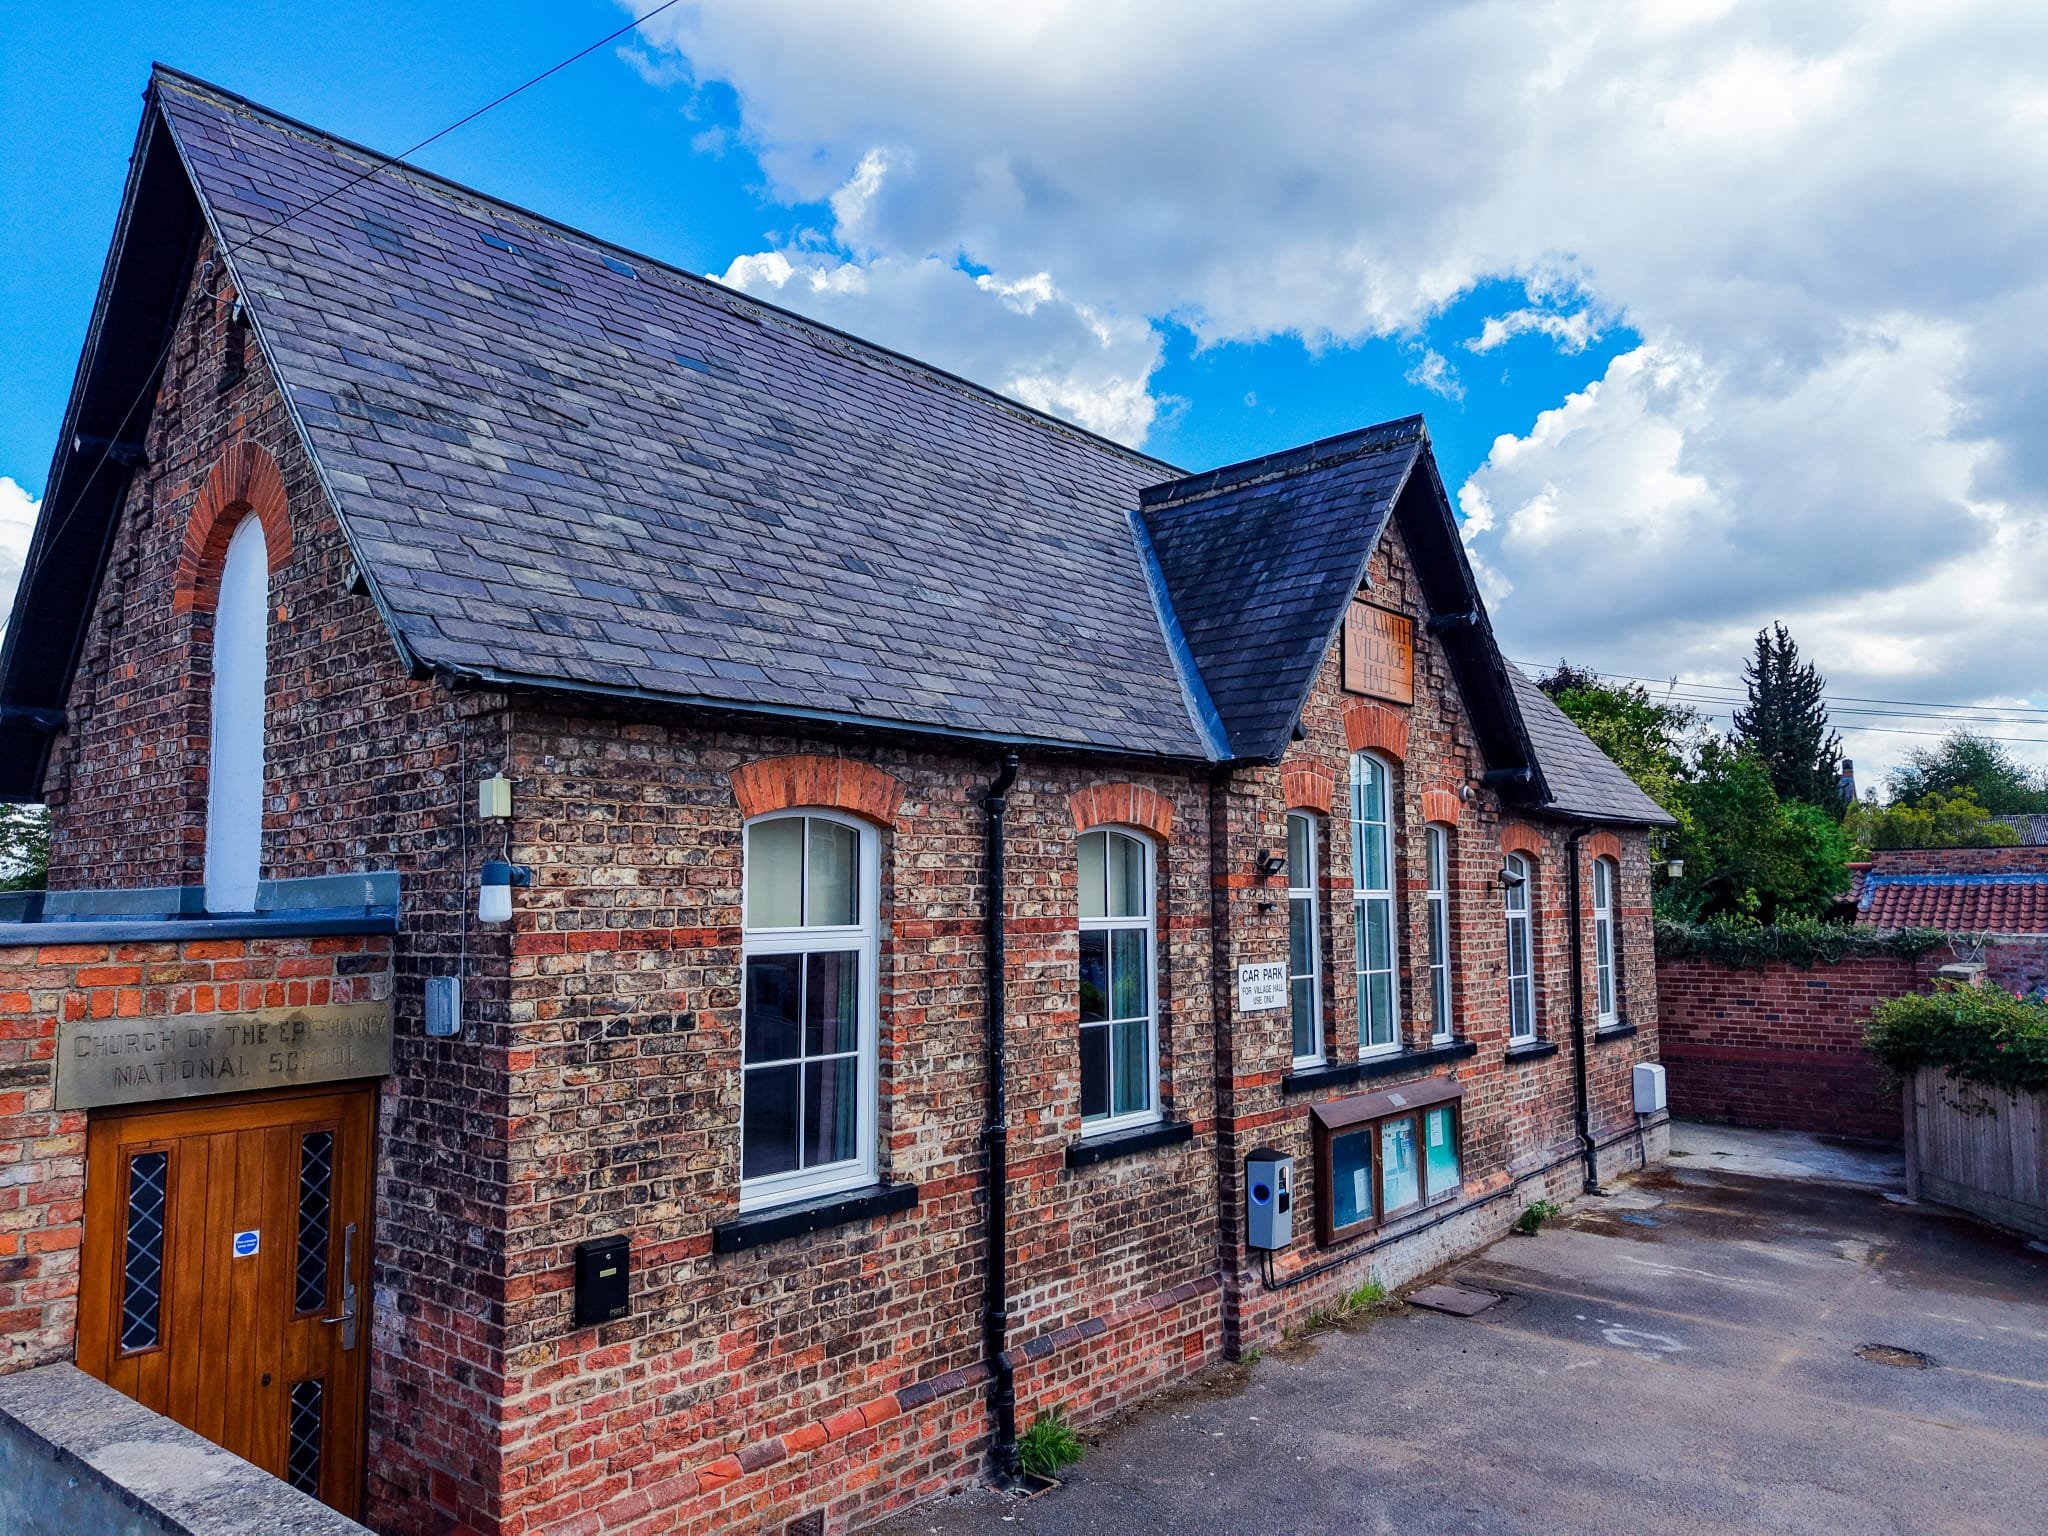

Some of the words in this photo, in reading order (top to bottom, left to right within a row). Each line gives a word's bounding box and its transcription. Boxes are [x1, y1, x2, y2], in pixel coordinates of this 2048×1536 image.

[1353, 633, 1406, 671] VILLAGE
[1363, 662, 1397, 696] HALL
[1242, 969, 1259, 982] CAR
[1263, 967, 1283, 980] PARK
[1242, 986, 1252, 996] FOR
[1254, 985, 1272, 994] VILLAGE
[1273, 984, 1284, 992] HALL
[1253, 996, 1262, 1005] USE
[1264, 995, 1274, 1004] ONLY
[74, 1030, 176, 1058] CHURCH
[187, 1027, 215, 1049] OF
[225, 1023, 268, 1047] THE
[279, 1015, 387, 1043] EPIPHANY
[114, 1055, 249, 1089] NATIONAL
[269, 1045, 357, 1074] SCHOOL
[610, 1305, 626, 1315] POST
